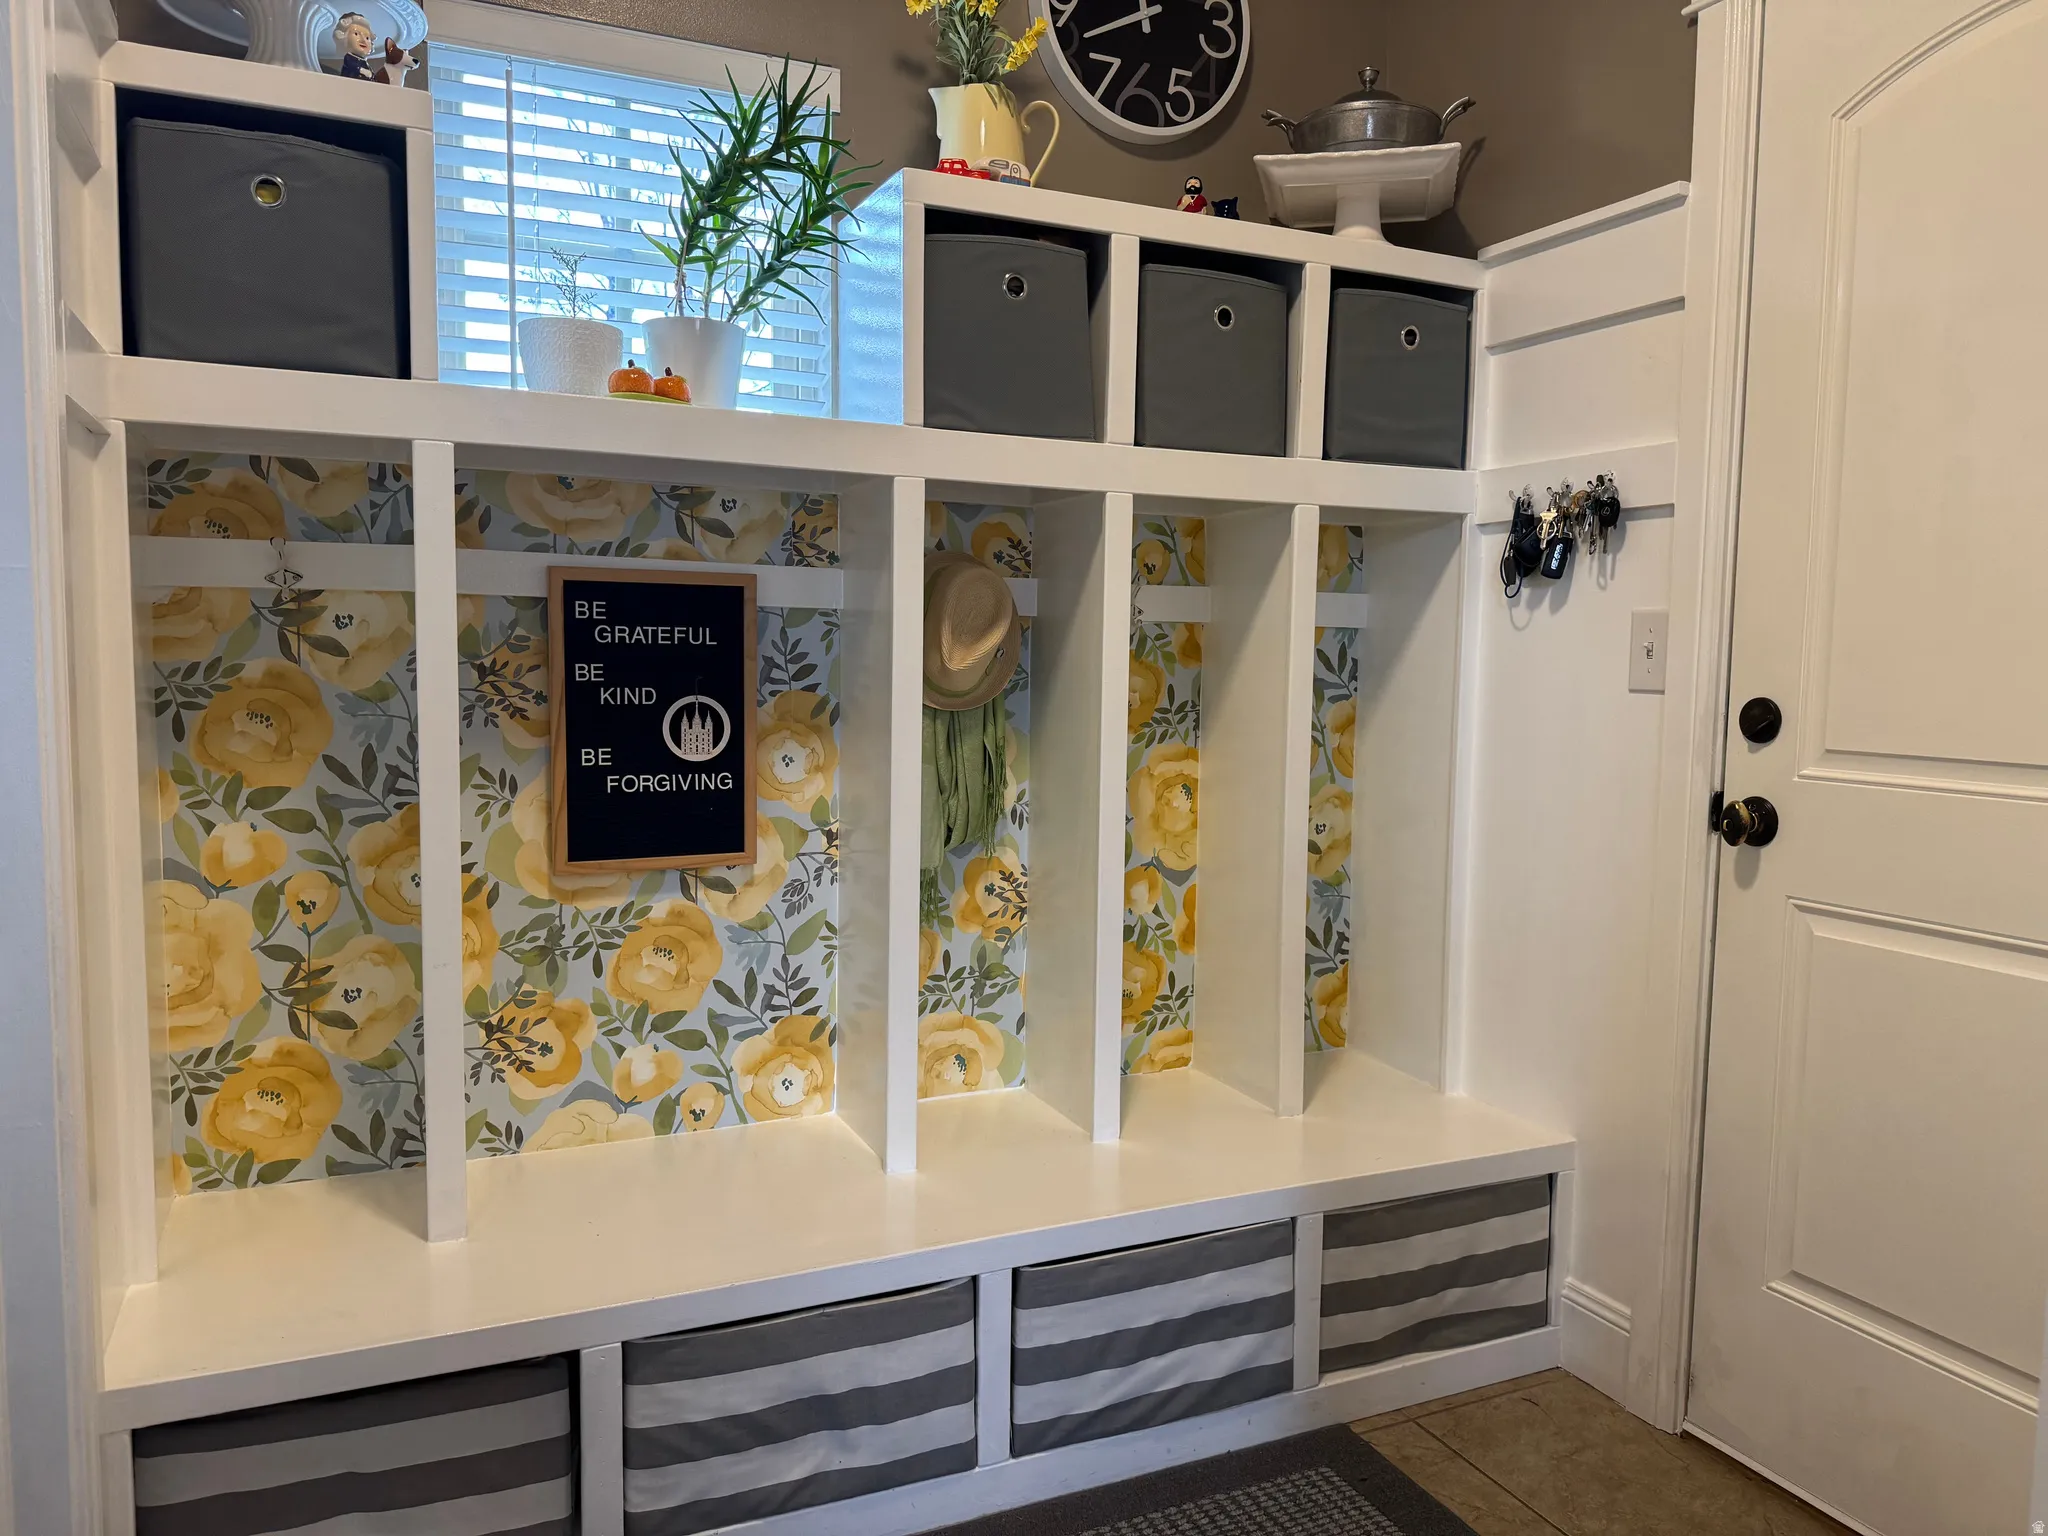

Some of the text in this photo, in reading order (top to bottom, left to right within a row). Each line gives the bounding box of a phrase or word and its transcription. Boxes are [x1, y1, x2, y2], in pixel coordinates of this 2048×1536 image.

[1198, 0, 1237, 59] 3
[1088, 52, 1122, 101] 7
[1114, 62, 1165, 127] 6
[1164, 67, 1196, 123] 5
[574, 600, 607, 619] BE
[594, 625, 718, 645] GRATEFUL
[574, 663, 605, 682] BE
[600, 687, 657, 705] KIND
[581, 748, 612, 766] BE
[606, 772, 733, 793] FORGIVING
